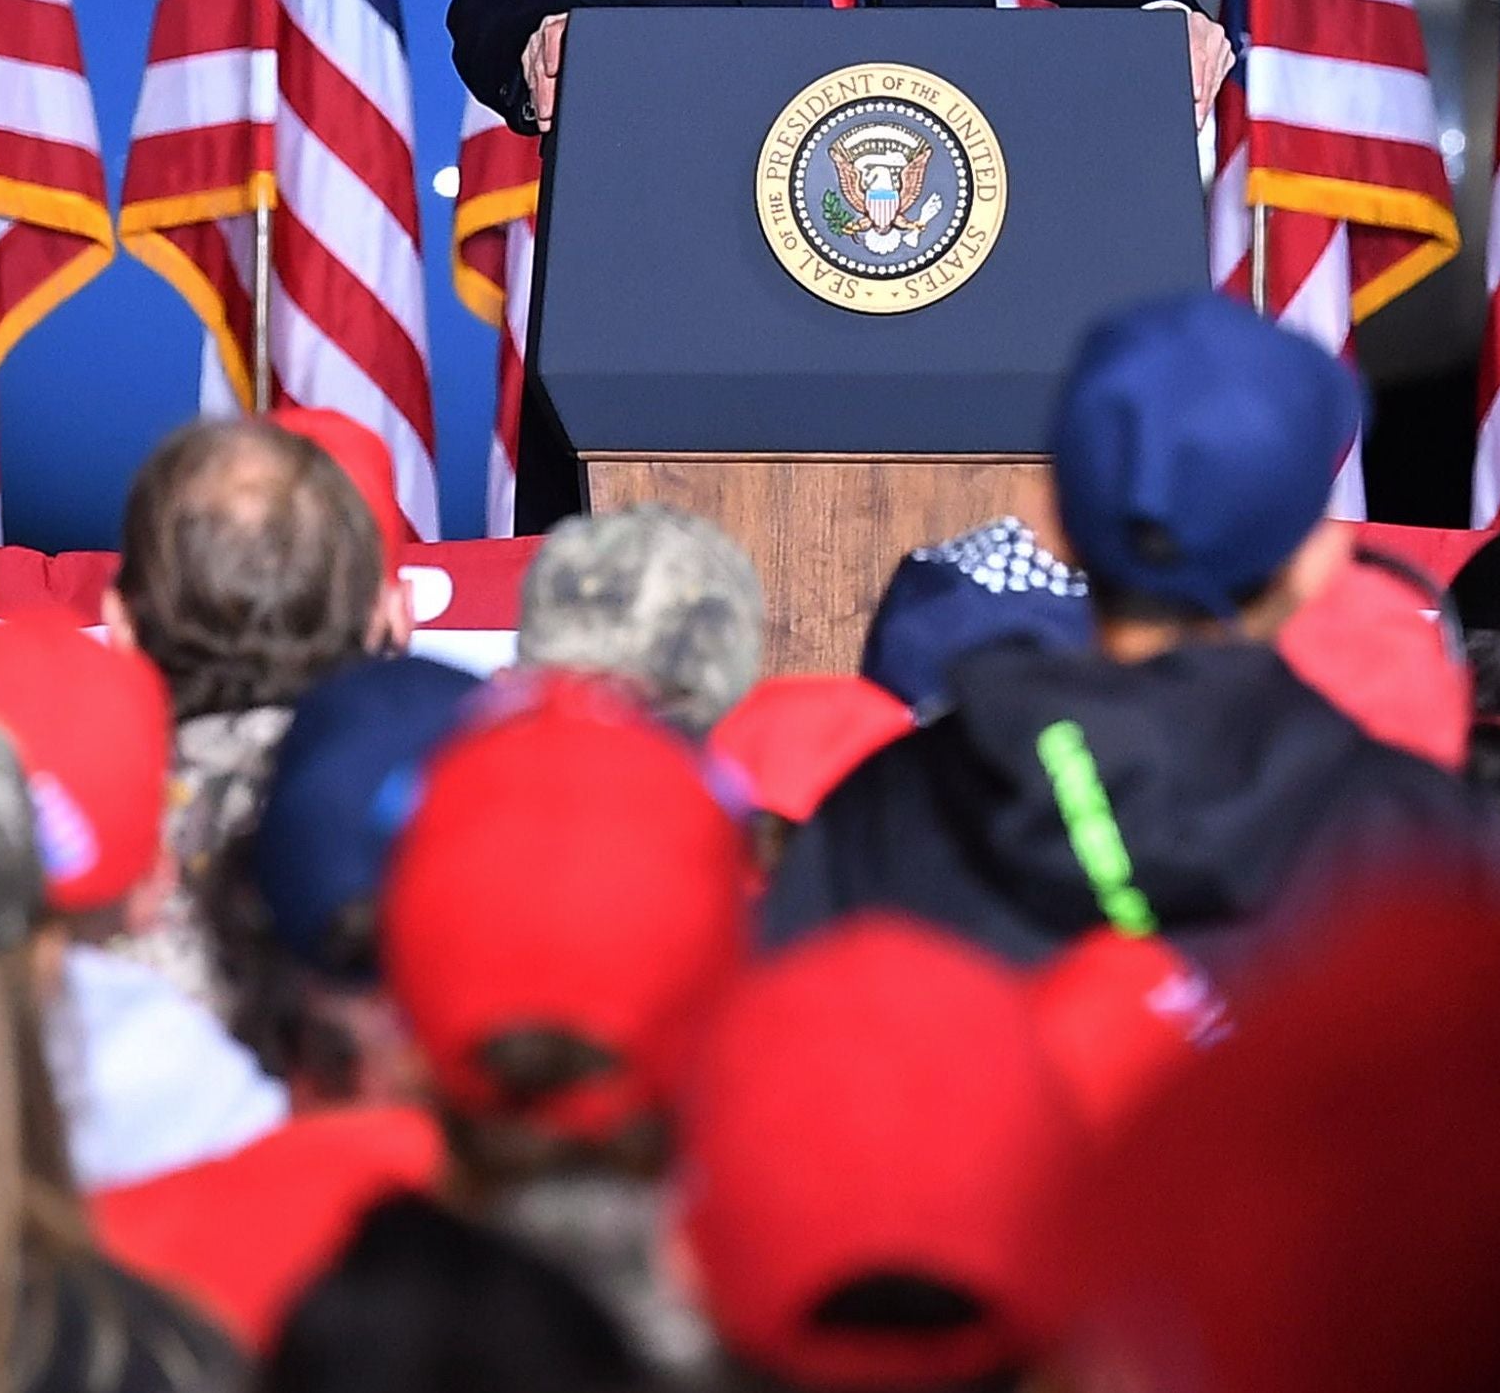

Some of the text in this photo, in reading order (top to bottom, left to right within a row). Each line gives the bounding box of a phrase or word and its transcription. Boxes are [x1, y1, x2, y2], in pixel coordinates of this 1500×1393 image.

[766, 73, 997, 299] SEAL OF THE PRESIDENT OF THE UNITED STATES
